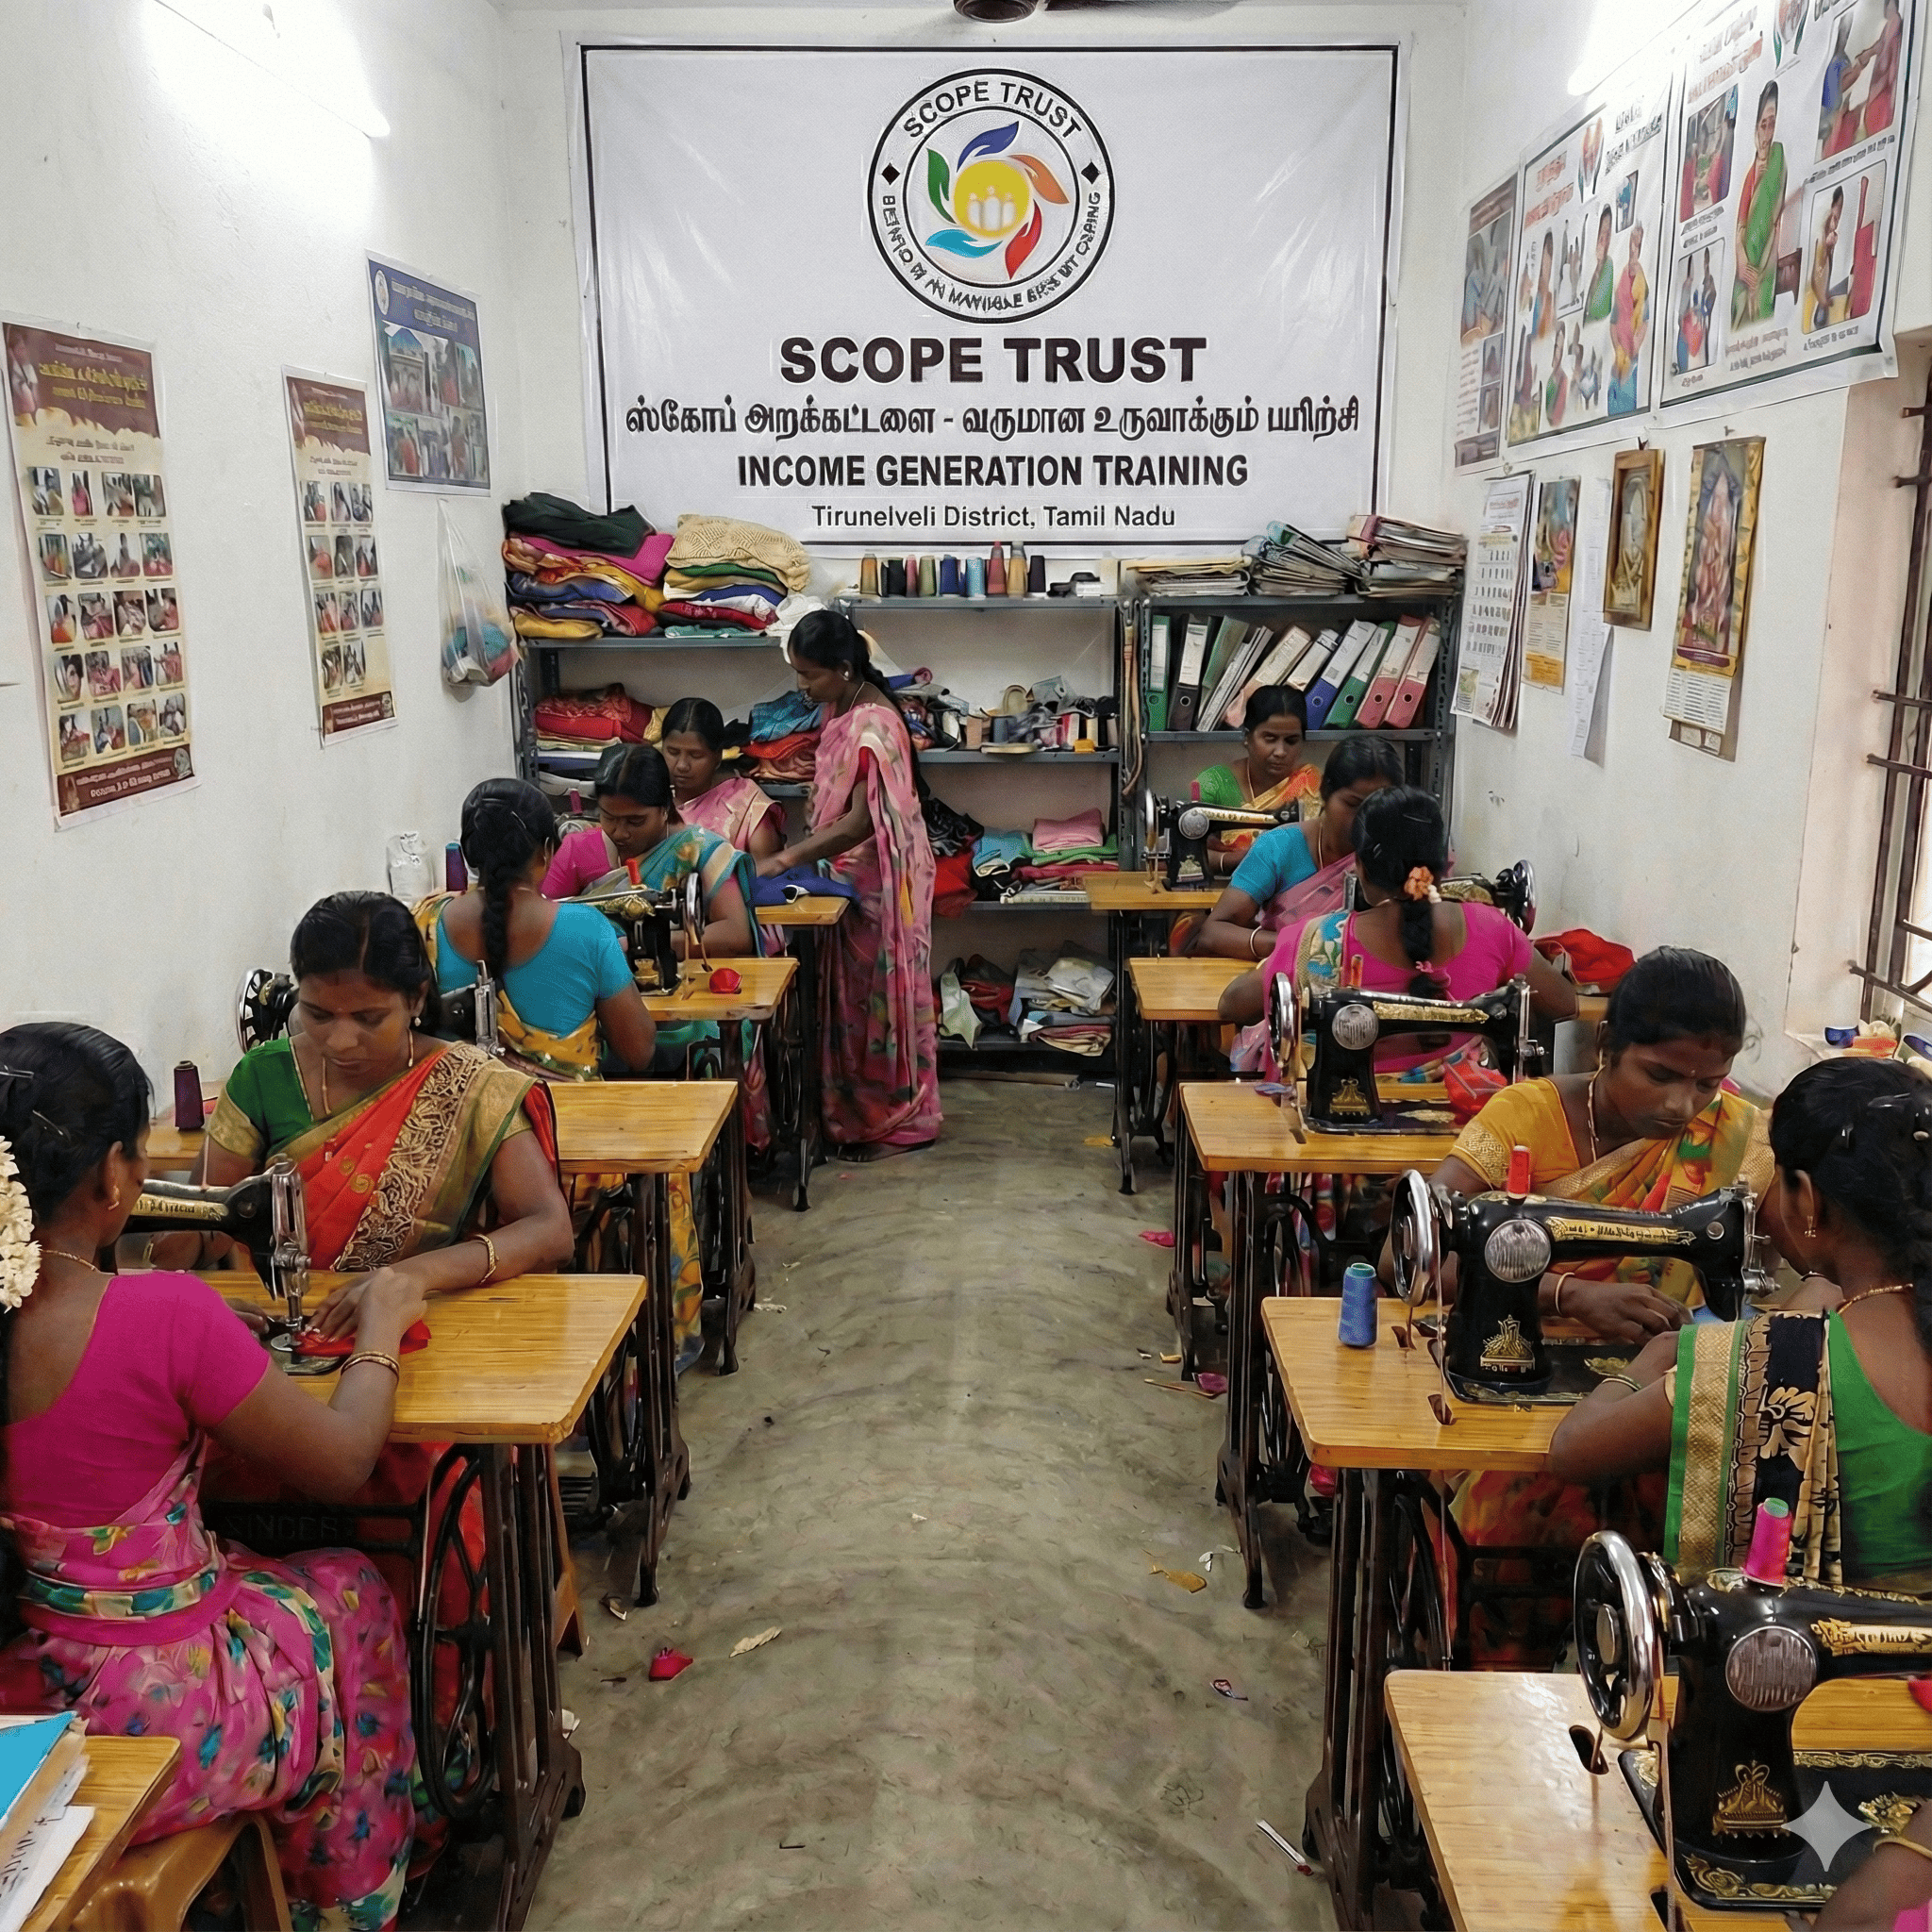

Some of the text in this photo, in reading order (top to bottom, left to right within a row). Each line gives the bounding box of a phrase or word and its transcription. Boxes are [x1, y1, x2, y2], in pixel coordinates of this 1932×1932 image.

[904, 81, 1082, 139] SCOPE TRUST
[781, 337, 1207, 384] SCOPE TRUST
[625, 394, 737, 433] ஸ்கோப்
[744, 394, 936, 442] அறக்கட்டளை
[962, 408, 1086, 441] வருமான
[1093, 394, 1259, 441] உருவாக்கும்
[1267, 394, 1359, 442] பயிற்சி
[739, 455, 1248, 487] INCOME GENERATION TRAINING
[812, 505, 1174, 528] Tirunelveli District, Tamil Nadu
